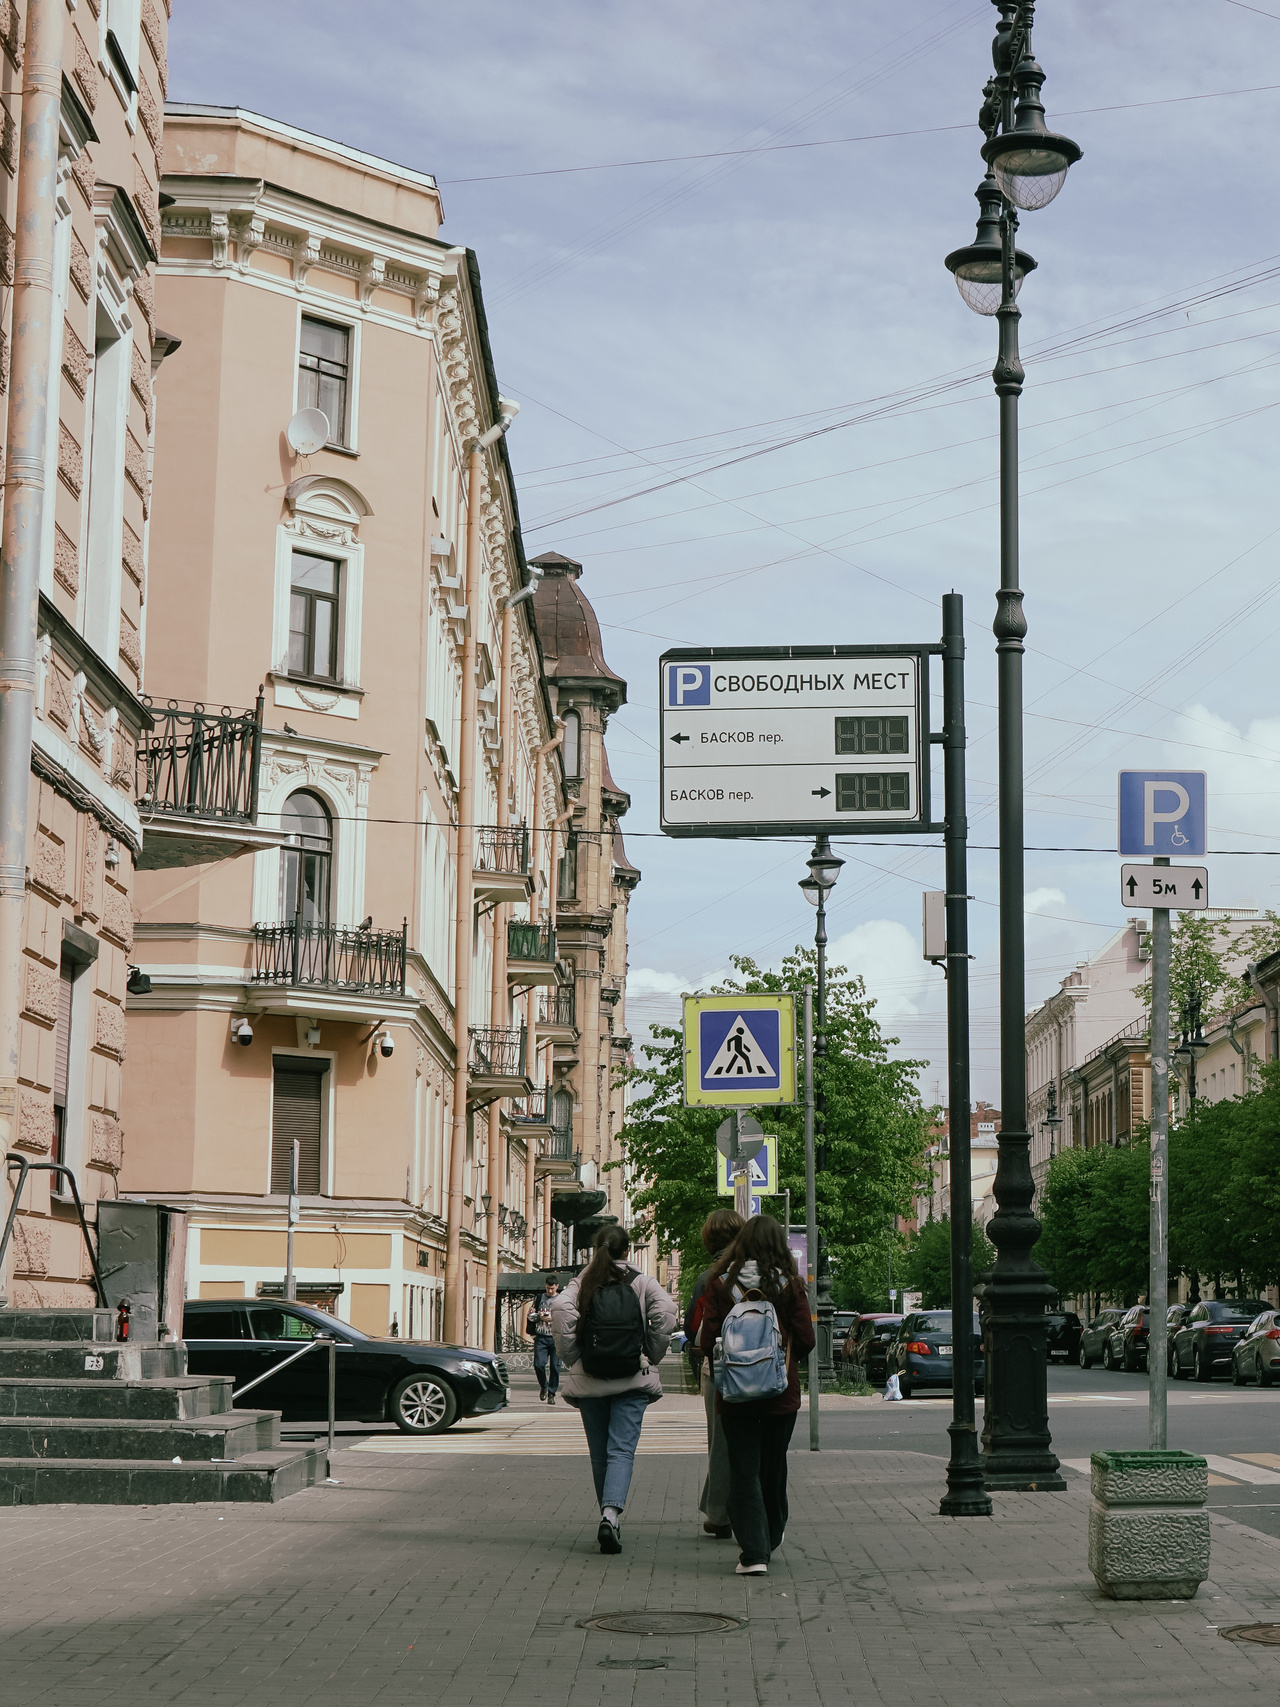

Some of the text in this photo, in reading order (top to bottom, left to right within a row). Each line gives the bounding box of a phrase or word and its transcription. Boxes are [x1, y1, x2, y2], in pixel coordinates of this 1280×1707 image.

[714, 673, 845, 694] СВОБОДНЫХ
[853, 672, 910, 690] МЕСТ
[700, 732, 784, 745] БАСКОВ пер.
[670, 789, 754, 802] БАСКОВ пер.
[1144, 780, 1190, 846] P
